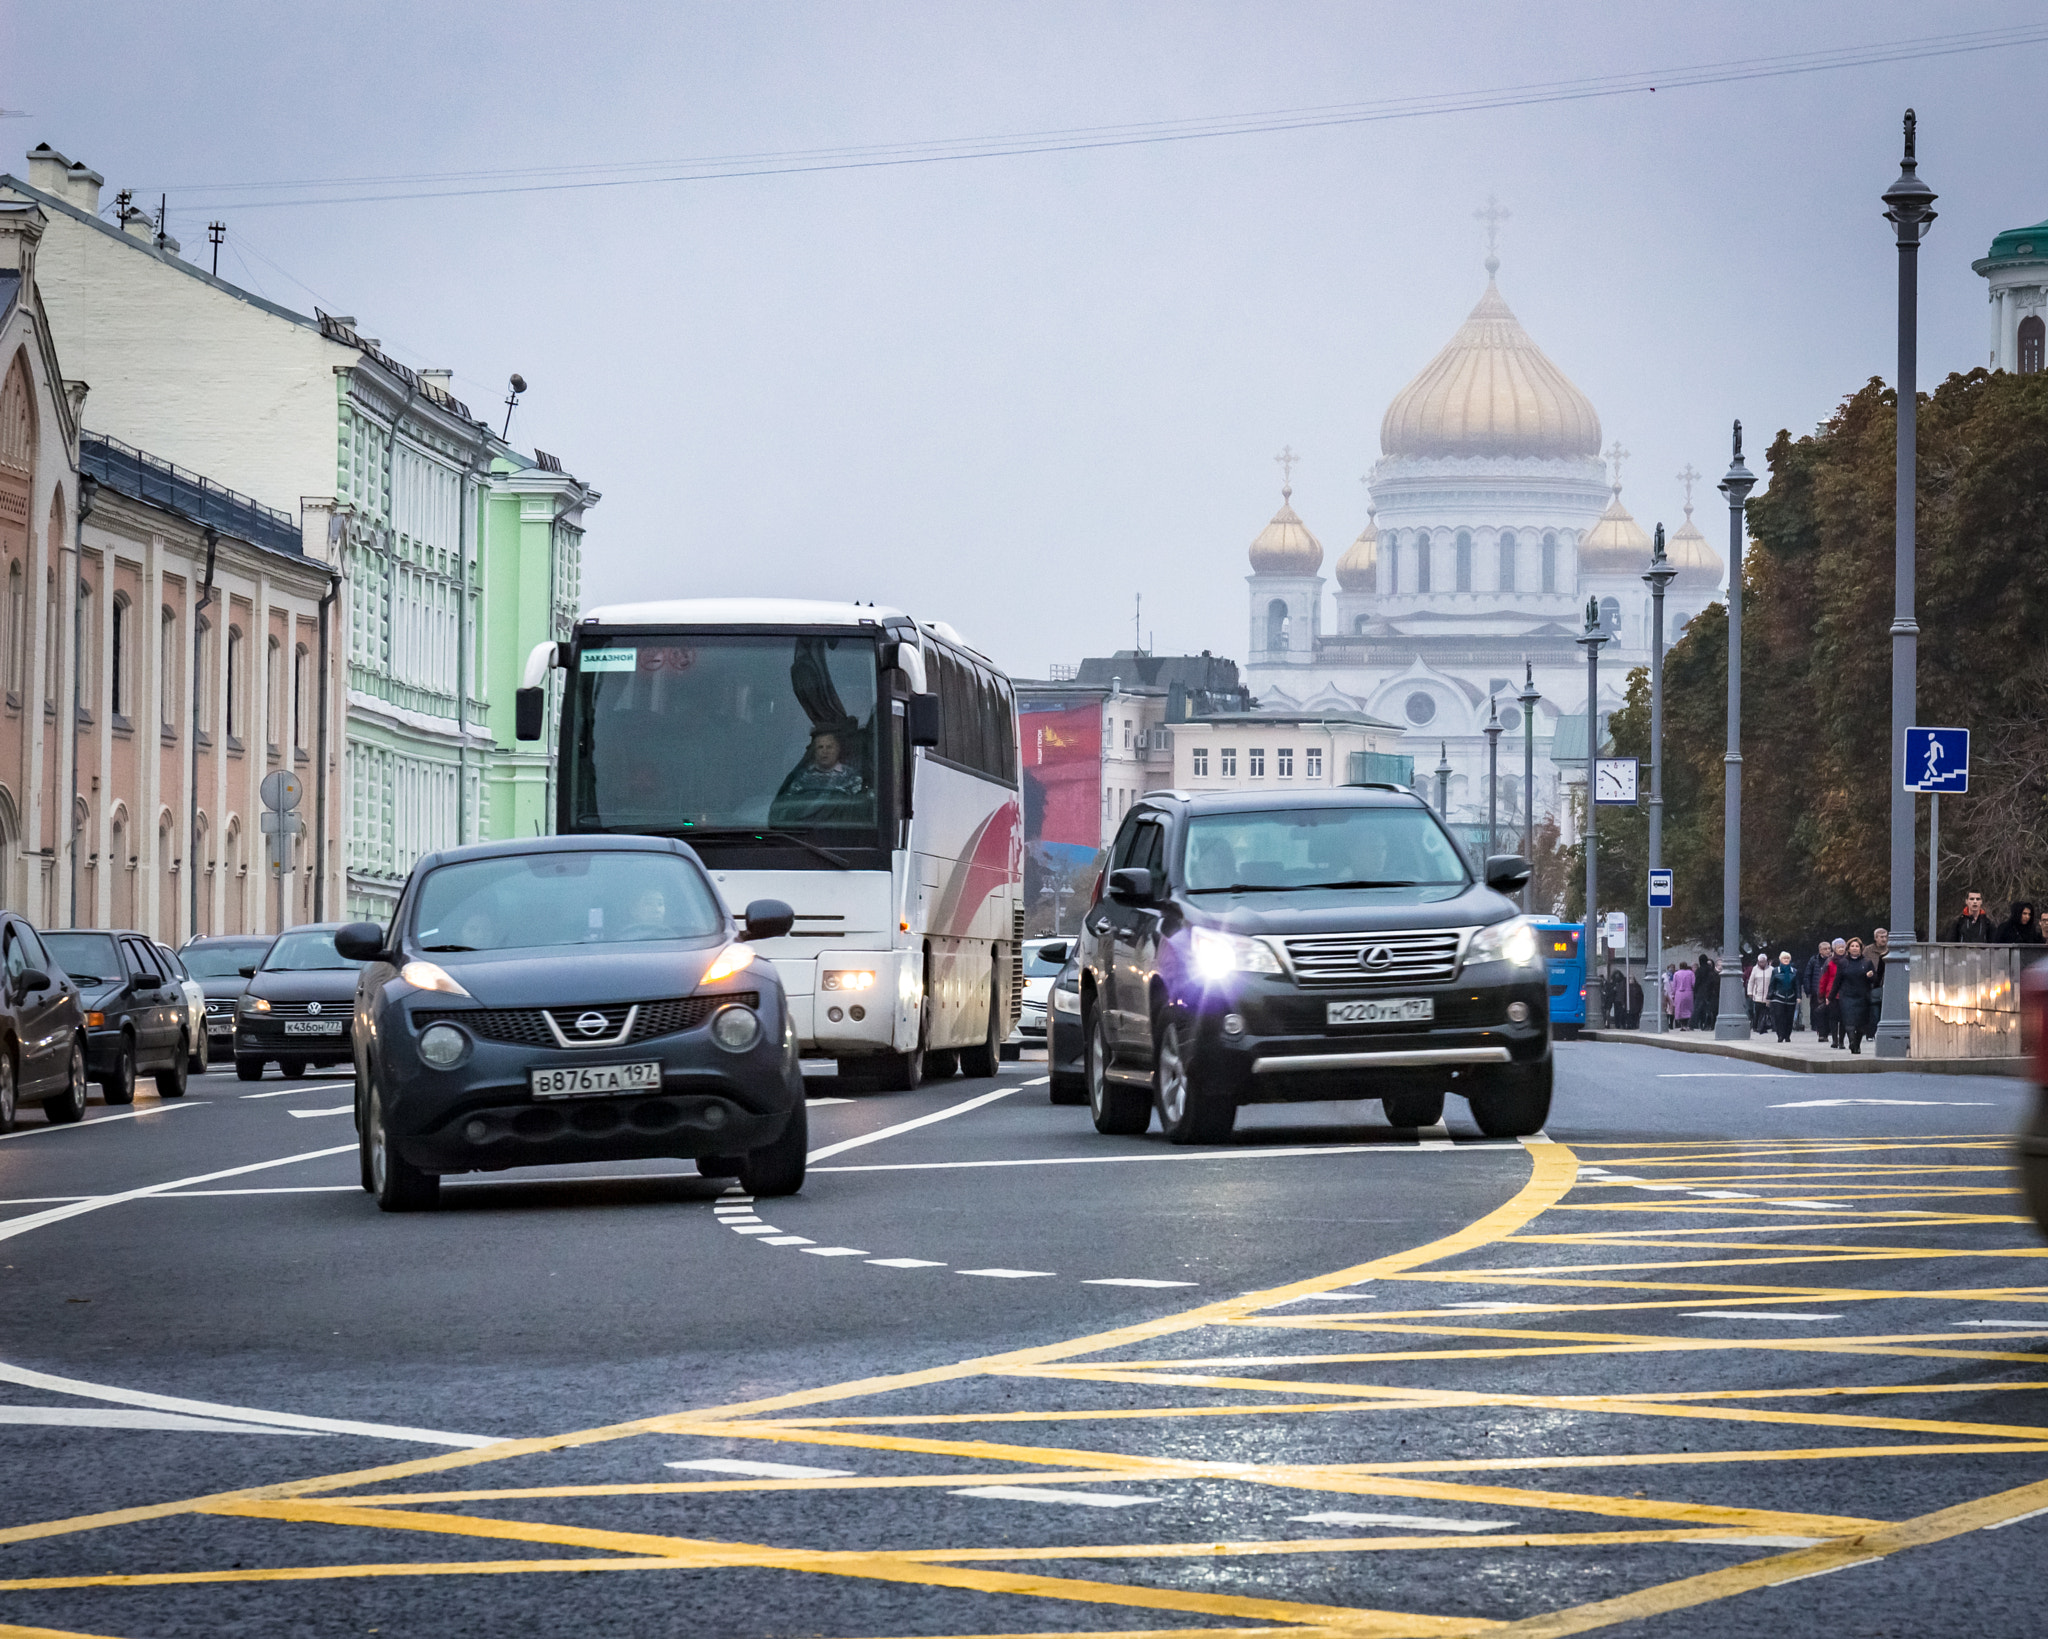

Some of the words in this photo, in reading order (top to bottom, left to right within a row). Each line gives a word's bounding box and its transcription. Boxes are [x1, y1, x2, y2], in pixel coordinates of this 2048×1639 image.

[584, 653, 634, 662] ЗАКАЗНОЙ
[540, 1070, 619, 1092] В876ТА
[624, 1065, 653, 1080] 197
